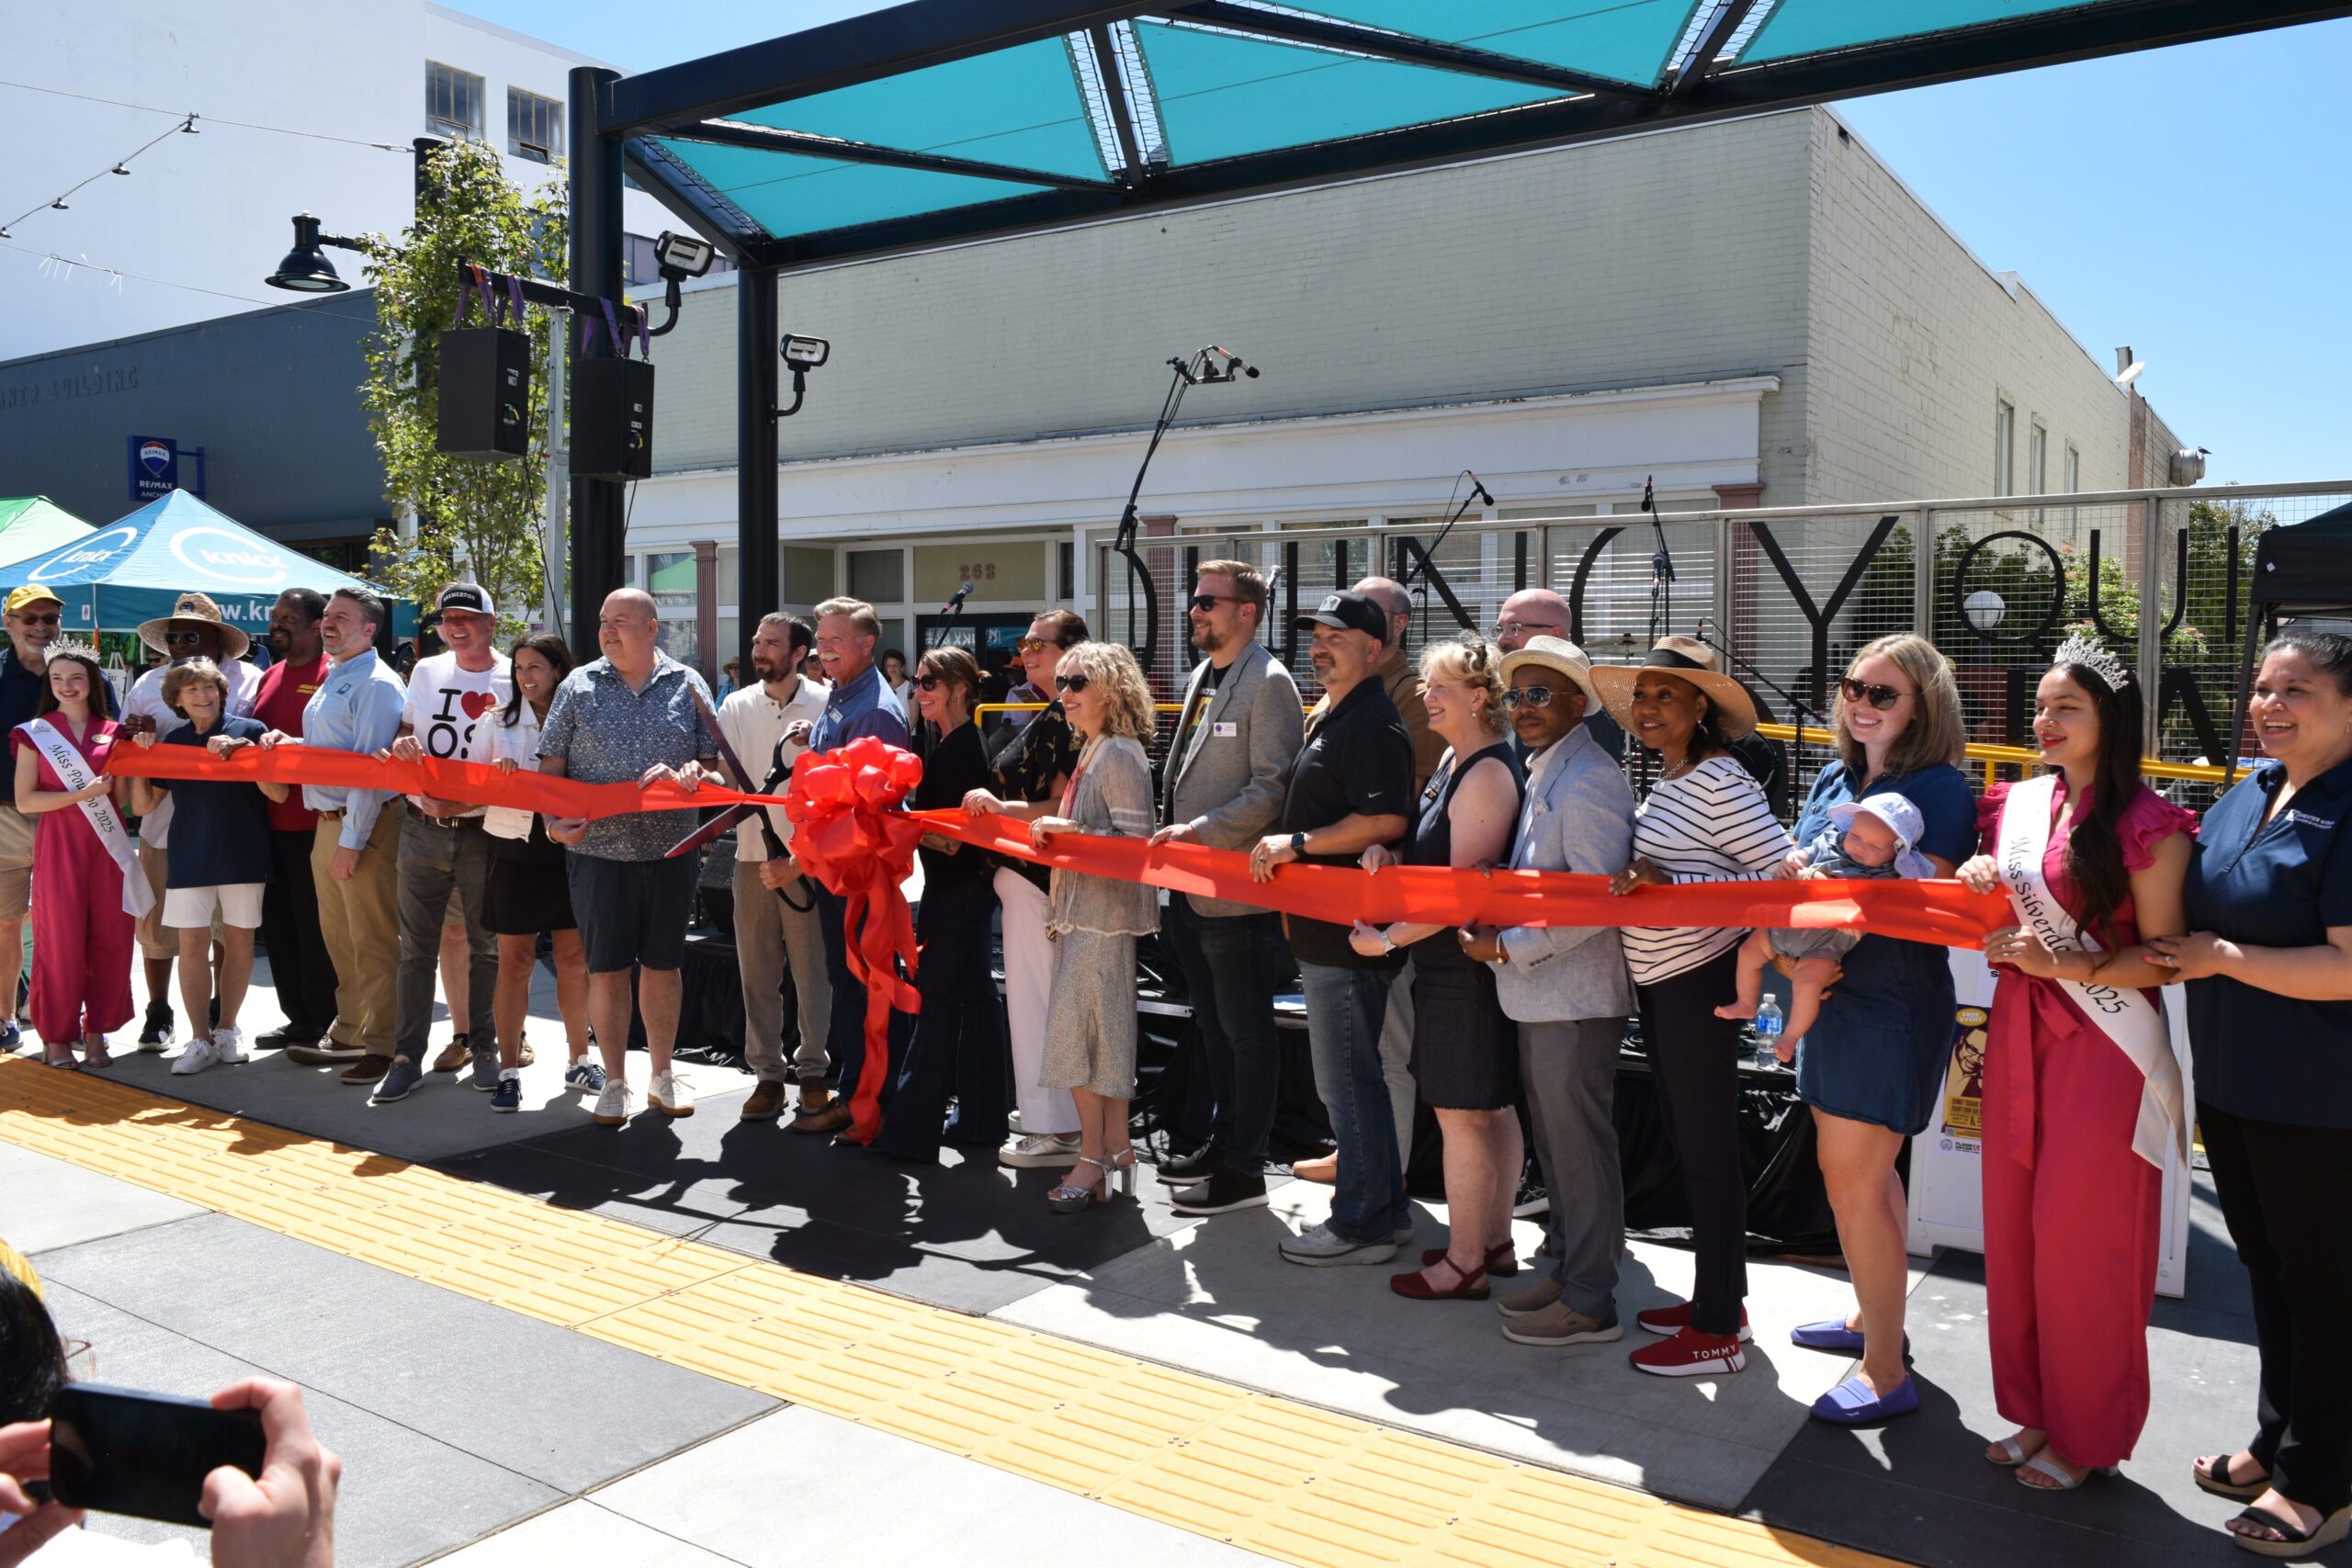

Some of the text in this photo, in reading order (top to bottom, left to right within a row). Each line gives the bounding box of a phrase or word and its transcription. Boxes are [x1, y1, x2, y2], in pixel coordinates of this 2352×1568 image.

[140, 480, 173, 490] RE/MAX
[199, 549, 289, 570] knkx
[959, 563, 996, 581] 263
[443, 591, 477, 603] BREMERTON
[432, 688, 462, 722] I
[48, 743, 73, 769] Miss
[94, 809, 116, 833] 2025
[2007, 837, 2032, 880] Miss
[1692, 1344, 1736, 1360] TOMMY
